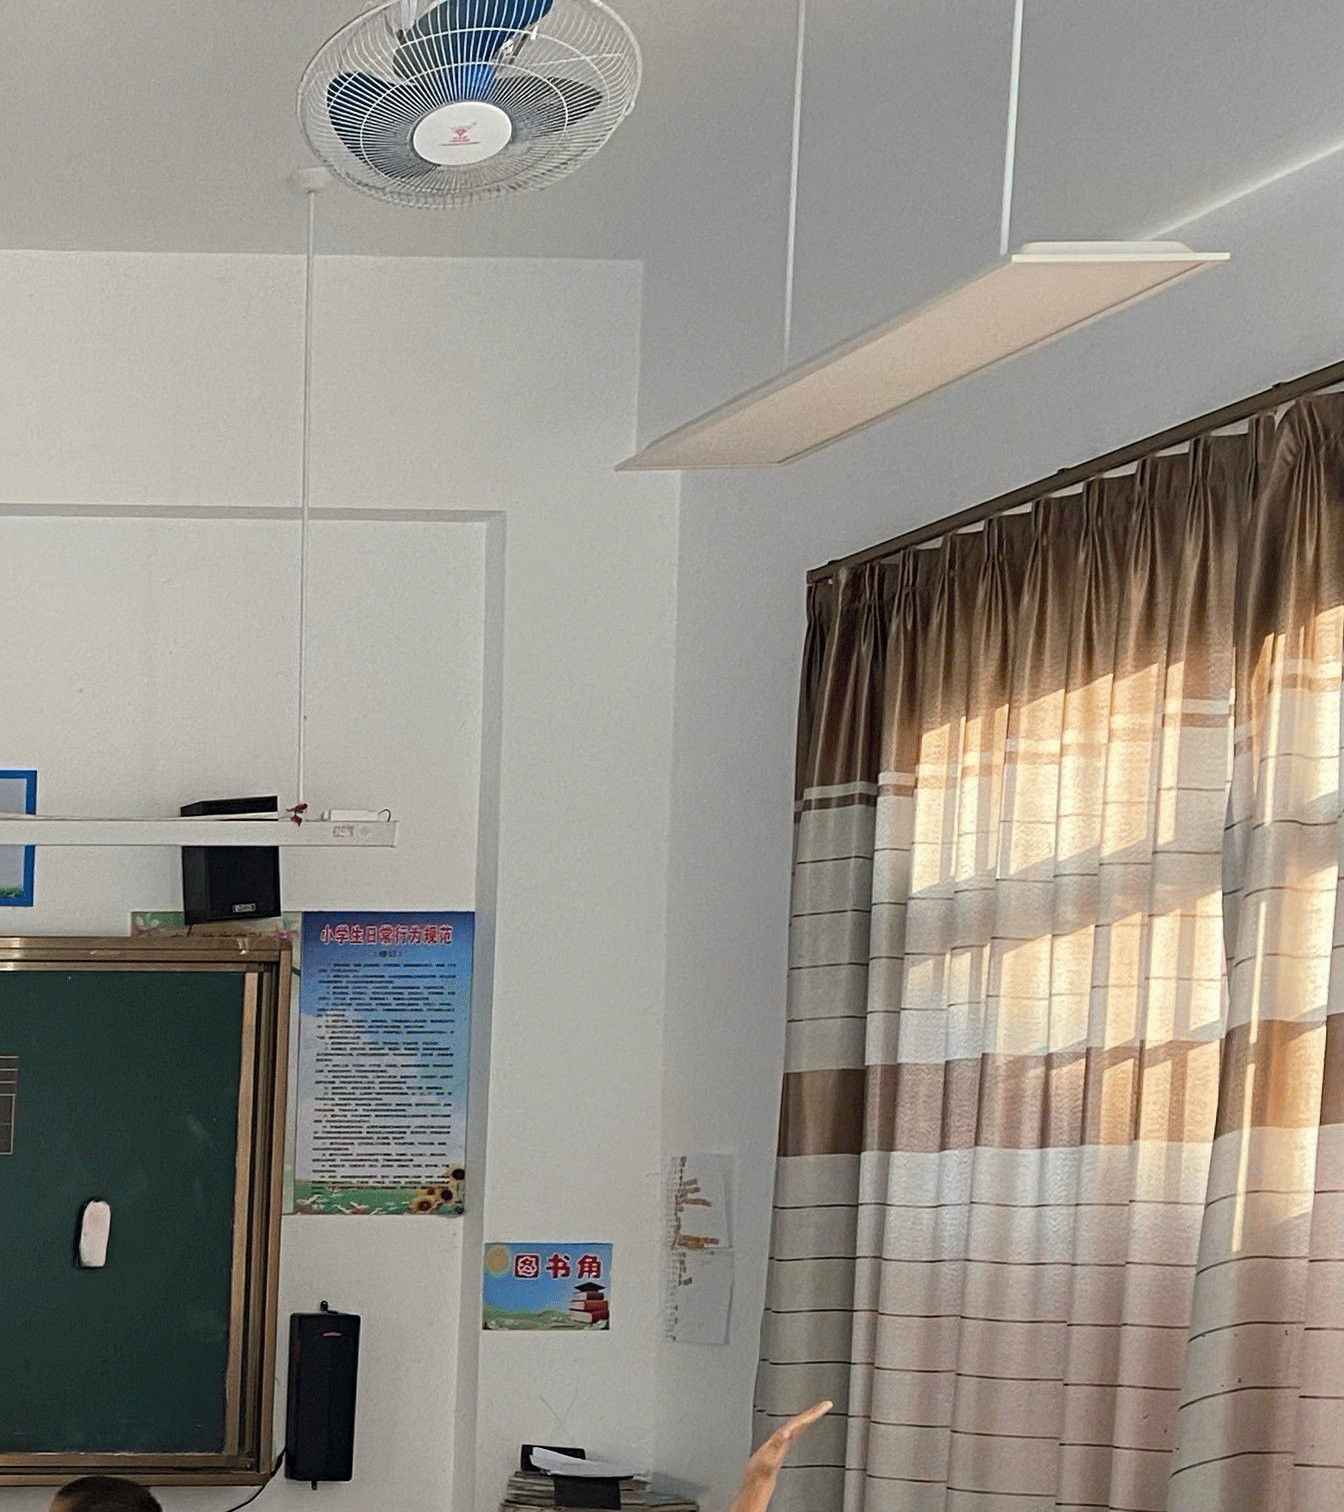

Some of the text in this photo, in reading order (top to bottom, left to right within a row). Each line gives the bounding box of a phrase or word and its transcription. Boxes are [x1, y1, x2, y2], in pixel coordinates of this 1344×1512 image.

[319, 924, 452, 945] 小学生日常行为规范
[514, 1253, 602, 1279] 图书角
